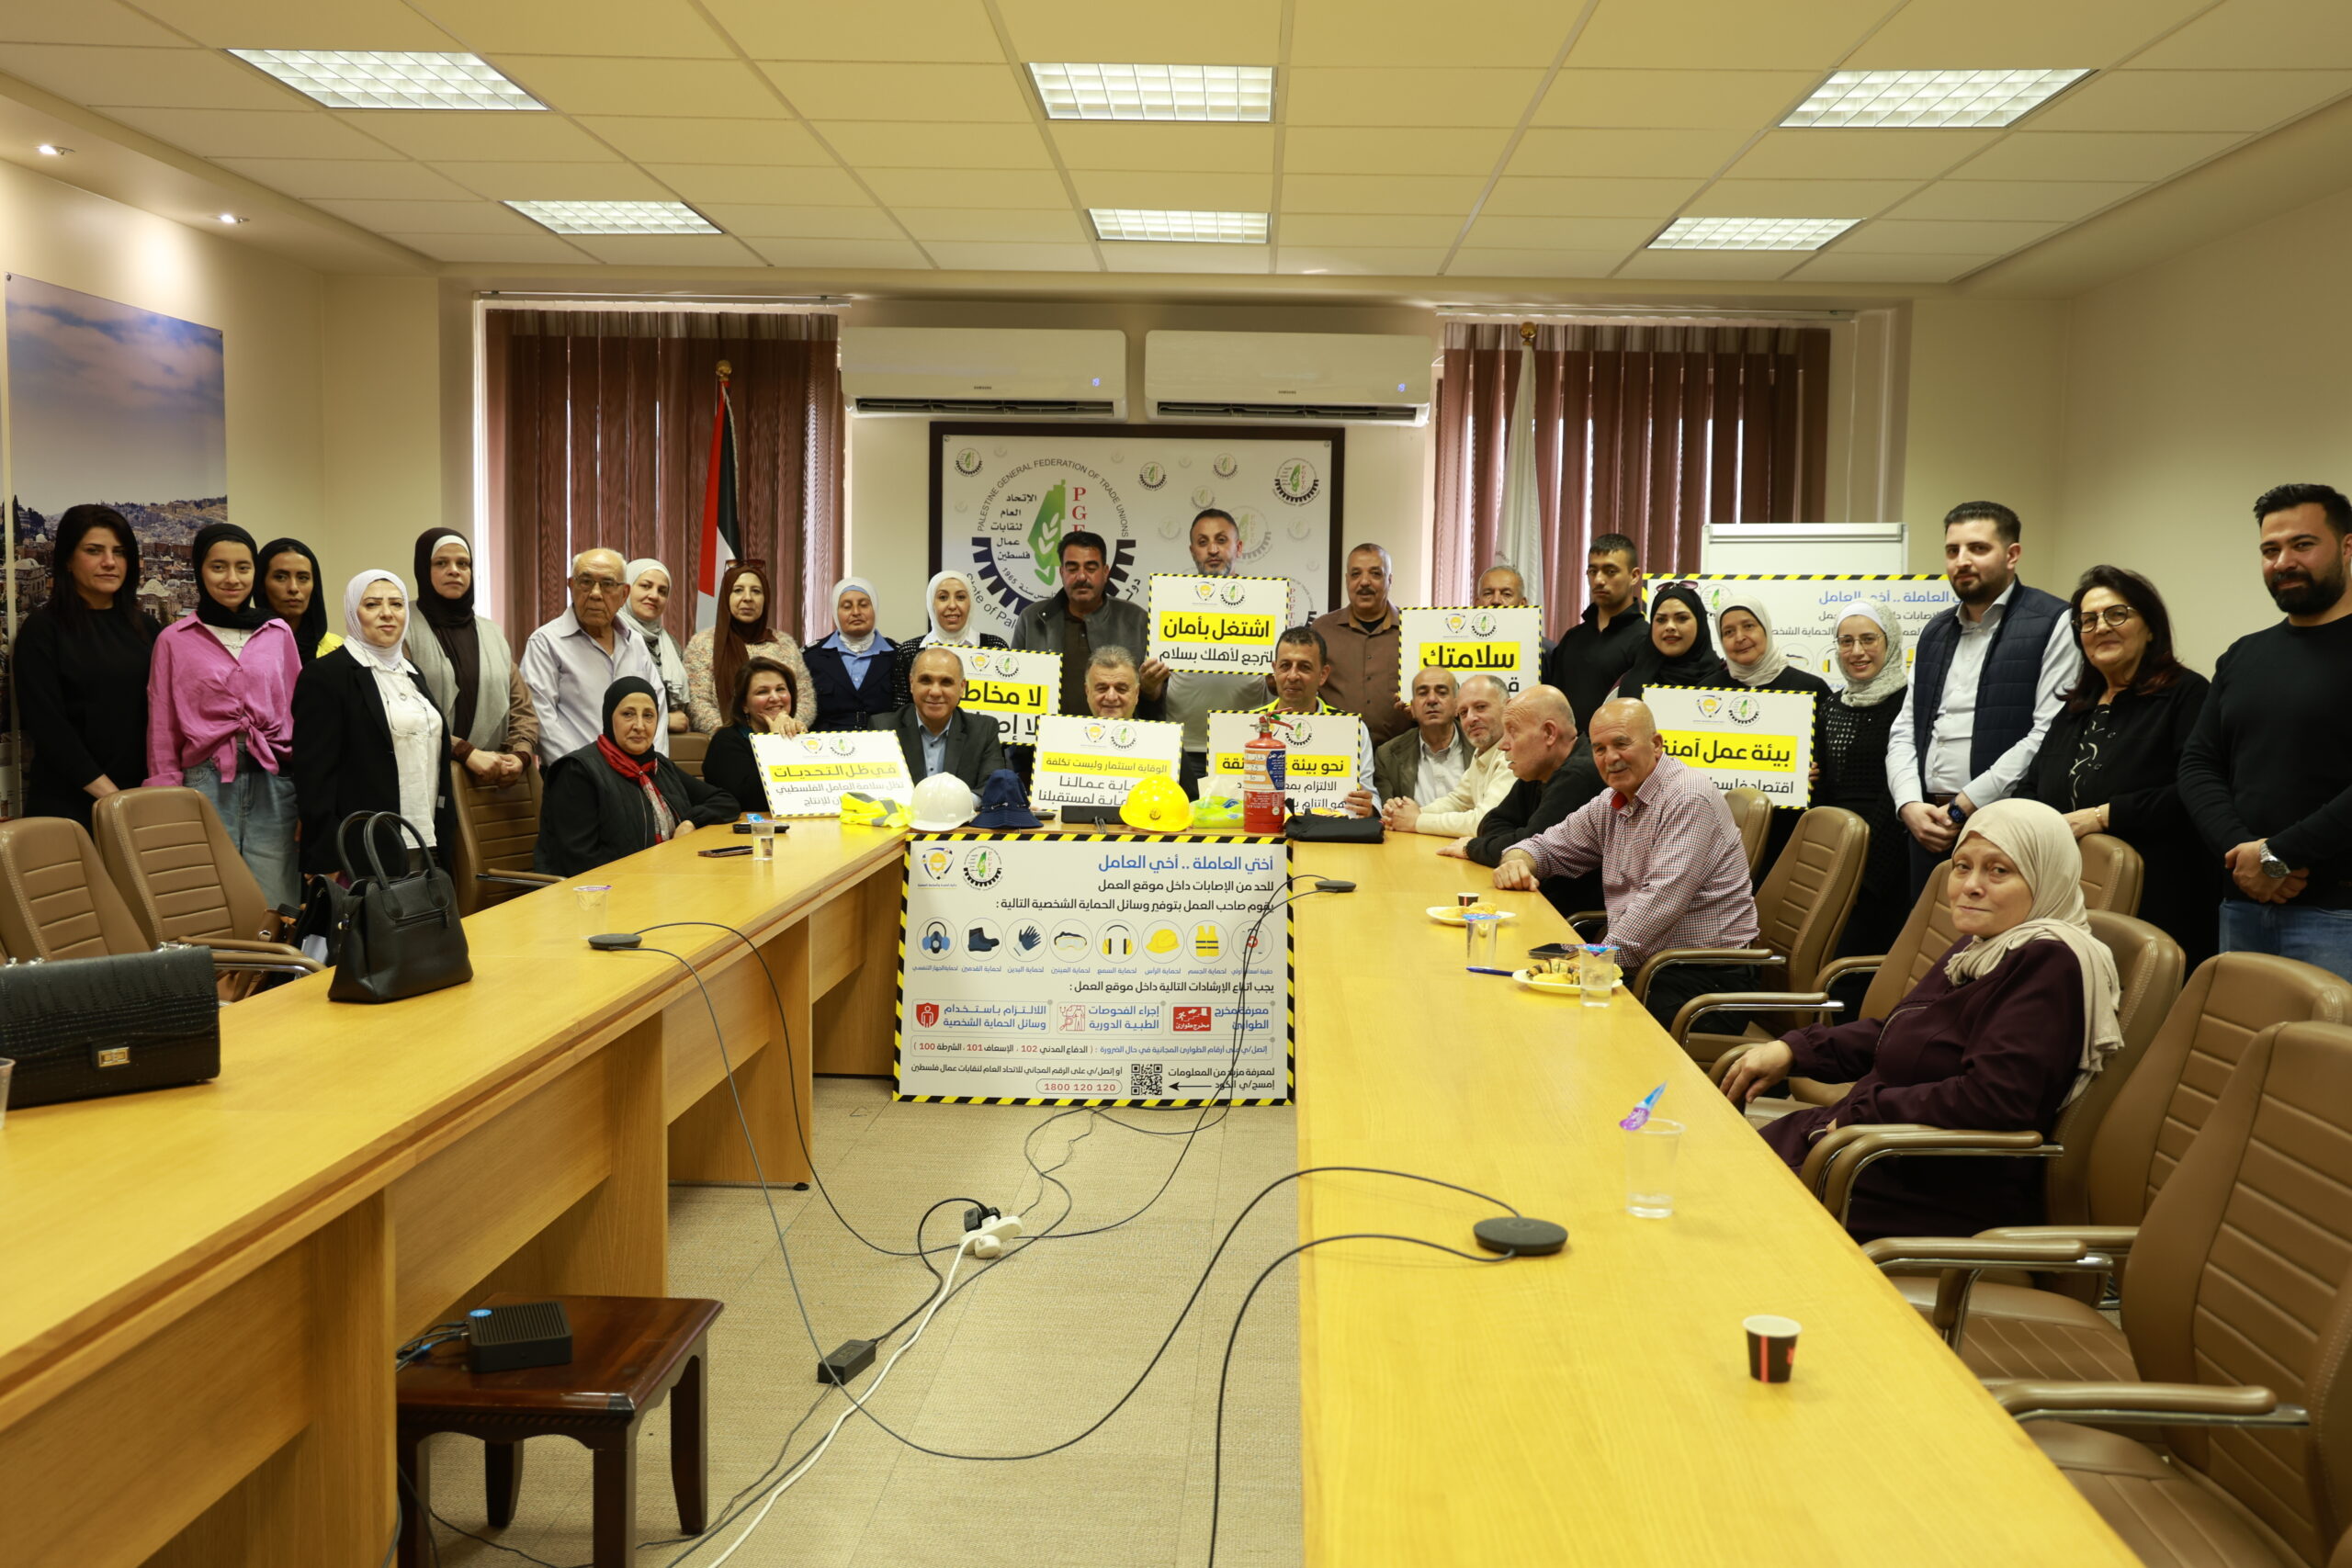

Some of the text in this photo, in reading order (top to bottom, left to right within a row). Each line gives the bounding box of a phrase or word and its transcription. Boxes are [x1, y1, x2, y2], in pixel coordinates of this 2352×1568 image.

[977, 458, 1129, 537] PALESTINE GENERAL FEDERATION OF TRADE UNIONS
[1001, 509, 1022, 518] العام
[990, 522, 1023, 533] لنقابات
[996, 536, 1020, 547] عمال
[998, 551, 1031, 562] فلسطين
[1002, 568, 1018, 584] 1965
[1904, 591, 1950, 603] العاملة
[983, 604, 998, 615] of
[1163, 615, 1270, 640] اشتغل بأمان
[1159, 647, 1273, 666] لترجع لأهلك بسلام
[1422, 645, 1515, 669] سلامتك
[959, 681, 1042, 707] لا مخاط
[1702, 740, 1747, 763] عمل
[1751, 743, 1790, 767] بيئة
[1046, 757, 1168, 775] الوقاية استثمار وليست تكلفة
[1292, 758, 1318, 775] بيئة
[1321, 759, 1344, 775] نحو
[774, 764, 897, 780] في ظل التحديات
[856, 781, 885, 790] سلامة
[1059, 775, 1104, 789] عمالنا
[1305, 781, 1337, 794] الالتزام
[775, 783, 824, 795] الفلسطيني
[827, 783, 855, 794] العامل
[1038, 789, 1095, 805] لمستقبلنا
[1099, 854, 1146, 872] العامل
[1148, 854, 1180, 874] أخي
[1193, 856, 1241, 871] العاملة
[1245, 855, 1273, 874] أختي
[1098, 879, 1274, 893] للحد من الإصابات داخل موقع العمل
[1001, 898, 1030, 911] التالية
[1032, 898, 1077, 911] الشخصية
[1079, 898, 1115, 911] الحماية
[1117, 899, 1149, 912] وسائل
[1152, 900, 1182, 912] بتوفير
[1183, 900, 1214, 913] العمل
[1216, 900, 1246, 913] صاحب
[1117, 967, 1137, 976] لحماية
[1074, 981, 1102, 992] العمل
[1105, 983, 1134, 994] موقع
[1135, 982, 1158, 994] داخل
[1159, 981, 1187, 994] التالية
[1189, 981, 1231, 994] الإرشادات
[1254, 983, 1274, 994] يجب
[1089, 1005, 1159, 1018] إجراء الفحوصات
[1215, 1007, 1269, 1017] معرفة مخرج
[943, 1018, 1046, 1031] وسائل الحماية الشخصية
[1090, 1020, 1159, 1031] الطبية الدورية
[919, 1042, 935, 1051] 100
[937, 1043, 961, 1053] الشرطة
[967, 1043, 983, 1052] 101
[1040, 1045, 1066, 1055] المدني
[1066, 1045, 1088, 1055] الدفاع
[1100, 1045, 1125, 1055] الضرورة
[1125, 1046, 1137, 1055] حال
[1139, 1045, 1151, 1055] في
[1152, 1045, 1178, 1055] المجانية
[1207, 1045, 1225, 1055] أرقام
[911, 1064, 939, 1073] فلسطين
[940, 1064, 957, 1073] عمال
[958, 1064, 982, 1073] لنقابات
[983, 1066, 1001, 1074] العام
[1023, 1066, 1051, 1075] المجاني
[1051, 1066, 1069, 1076] الرقم
[1070, 1066, 1086, 1075] على
[1115, 1066, 1123, 1075] أو
[1169, 1067, 1213, 1078] المعلومات
[1213, 1069, 1226, 1078] من
[1246, 1067, 1275, 1077] لمعرفة
[1044, 1082, 1116, 1091] 1800 120 120
